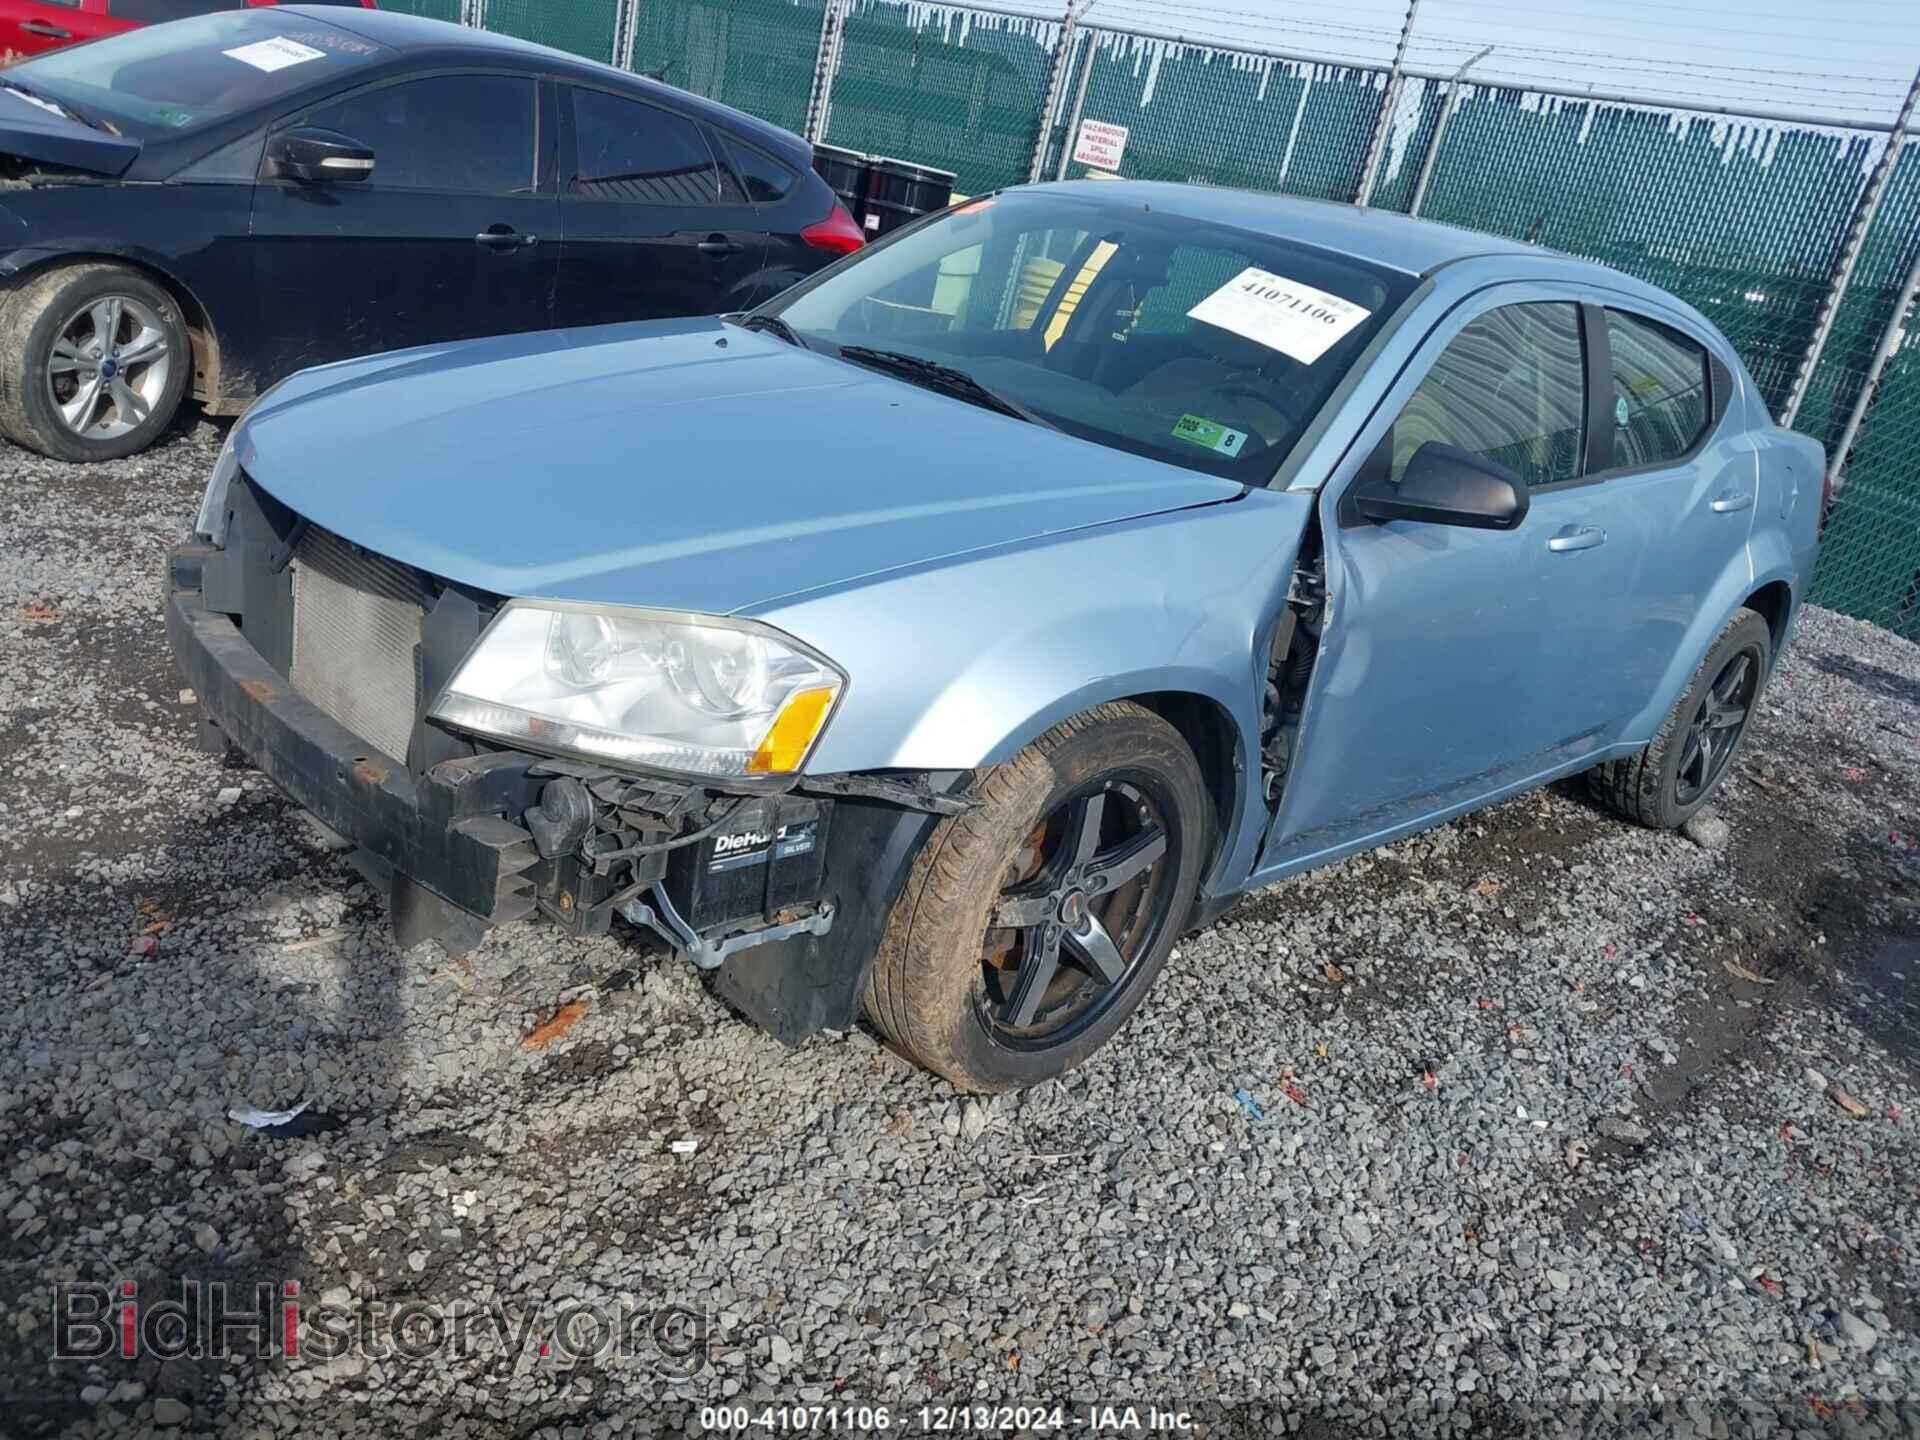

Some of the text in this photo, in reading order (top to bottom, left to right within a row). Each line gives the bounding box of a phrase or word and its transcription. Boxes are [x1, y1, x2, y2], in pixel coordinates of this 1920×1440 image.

[1083, 123, 1125, 138] HAZARDOUS
[1085, 134, 1118, 147] MATERIAL
[1090, 144, 1108, 155] SPILL
[1242, 282, 1338, 324] 41071106
[1224, 434, 1236, 447] 8
[714, 824, 788, 853] DieHad
[783, 841, 812, 854] SILVER
